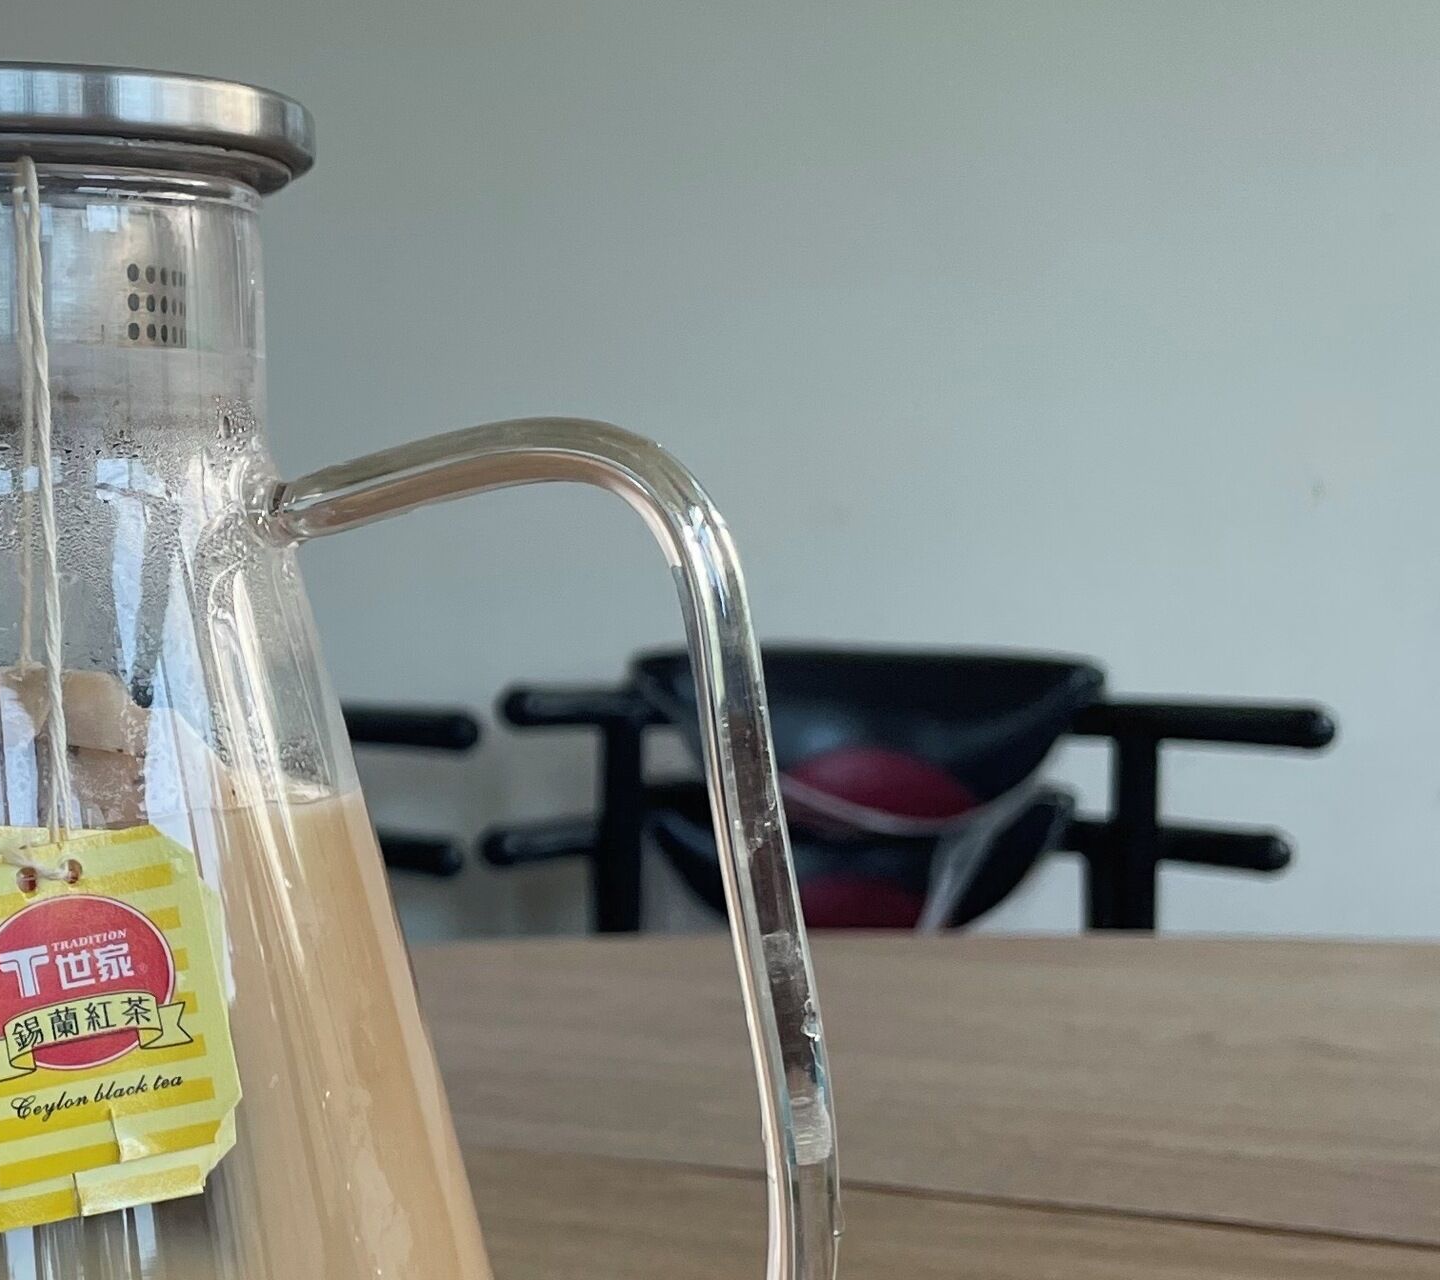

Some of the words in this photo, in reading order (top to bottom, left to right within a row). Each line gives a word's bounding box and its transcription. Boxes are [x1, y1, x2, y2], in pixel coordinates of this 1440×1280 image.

[51, 928, 128, 953] TRADITION
[11, 997, 153, 1052] 錫蘭紅茶
[10, 1093, 90, 1123] Ceylon
[93, 1073, 149, 1103] black
[154, 1073, 184, 1094] tea
